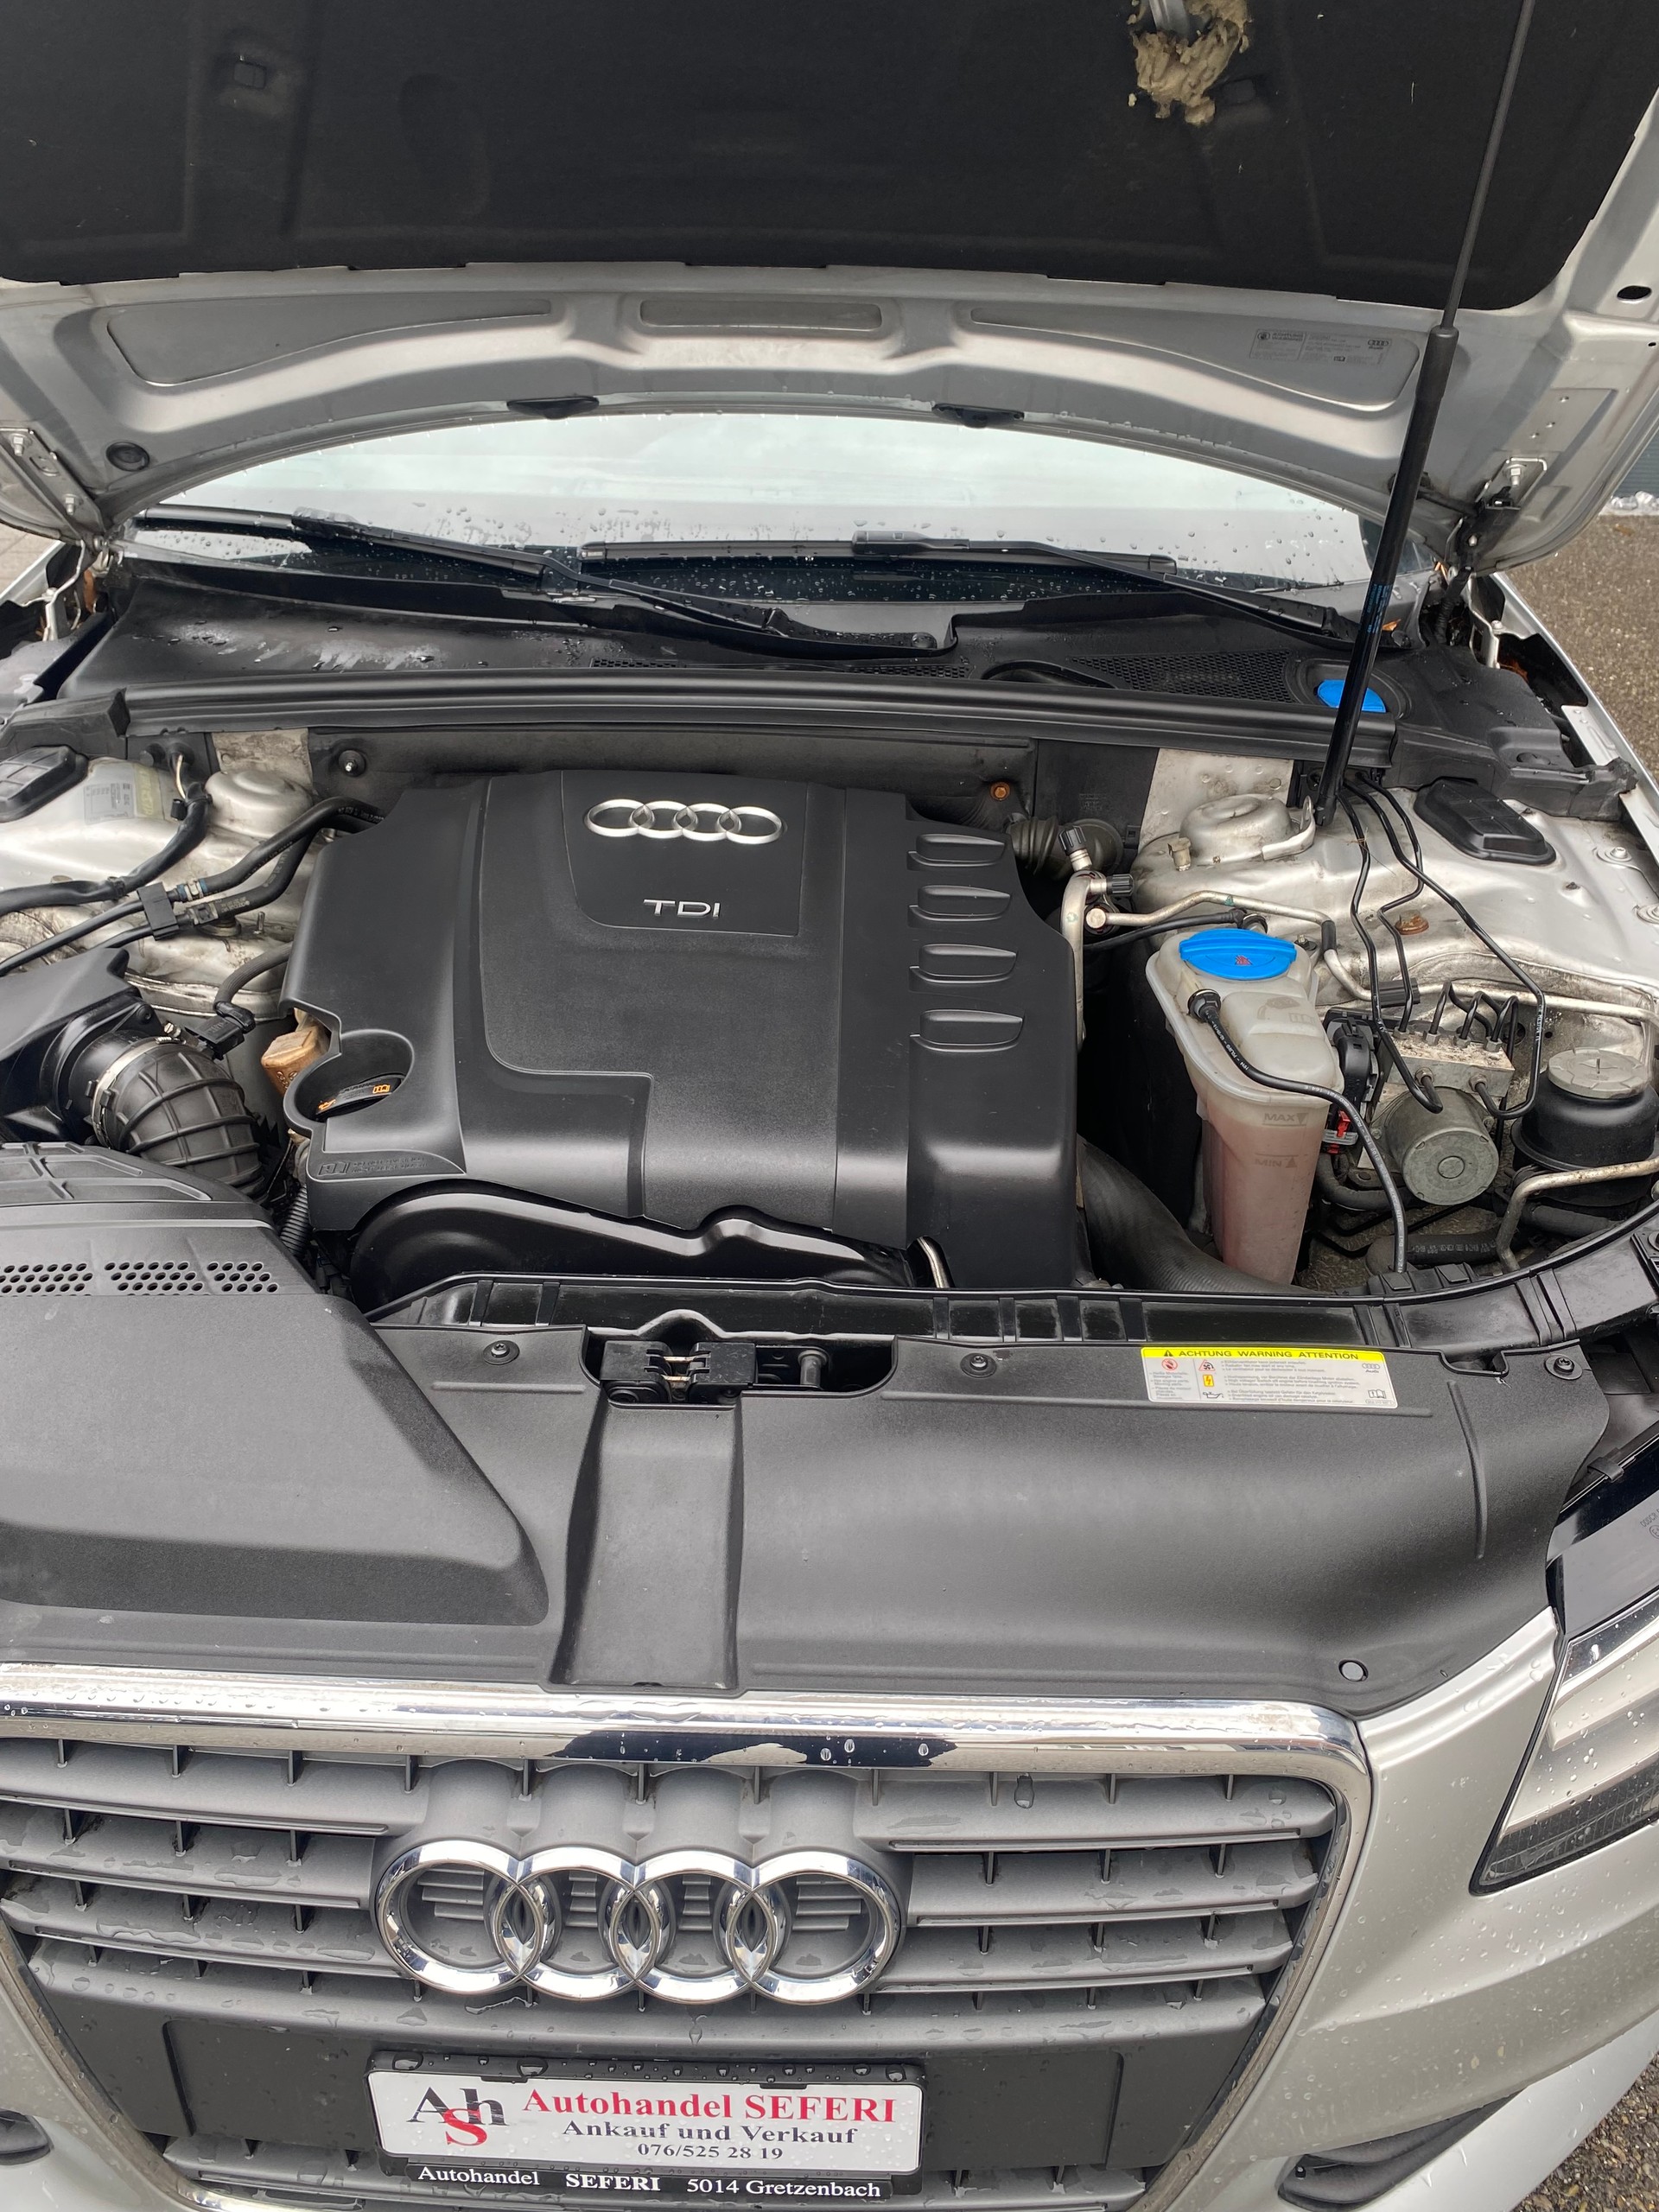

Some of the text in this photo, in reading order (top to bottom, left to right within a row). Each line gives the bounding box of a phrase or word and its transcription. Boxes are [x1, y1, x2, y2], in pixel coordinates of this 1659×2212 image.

[643, 899, 721, 918] TDI
[1264, 1112, 1296, 1122] MAX
[1255, 1159, 1282, 1167] MIN
[1298, 1351, 1359, 1360] ATTENTION
[522, 2088, 897, 2122] Autohandel SEFERI
[562, 2120, 859, 2144] Ankauf und Verkauf
[638, 2142, 783, 2159] 076/525 28 19
[418, 2166, 881, 2198] Autohandel SEFERI 5014 Gretzenbach
